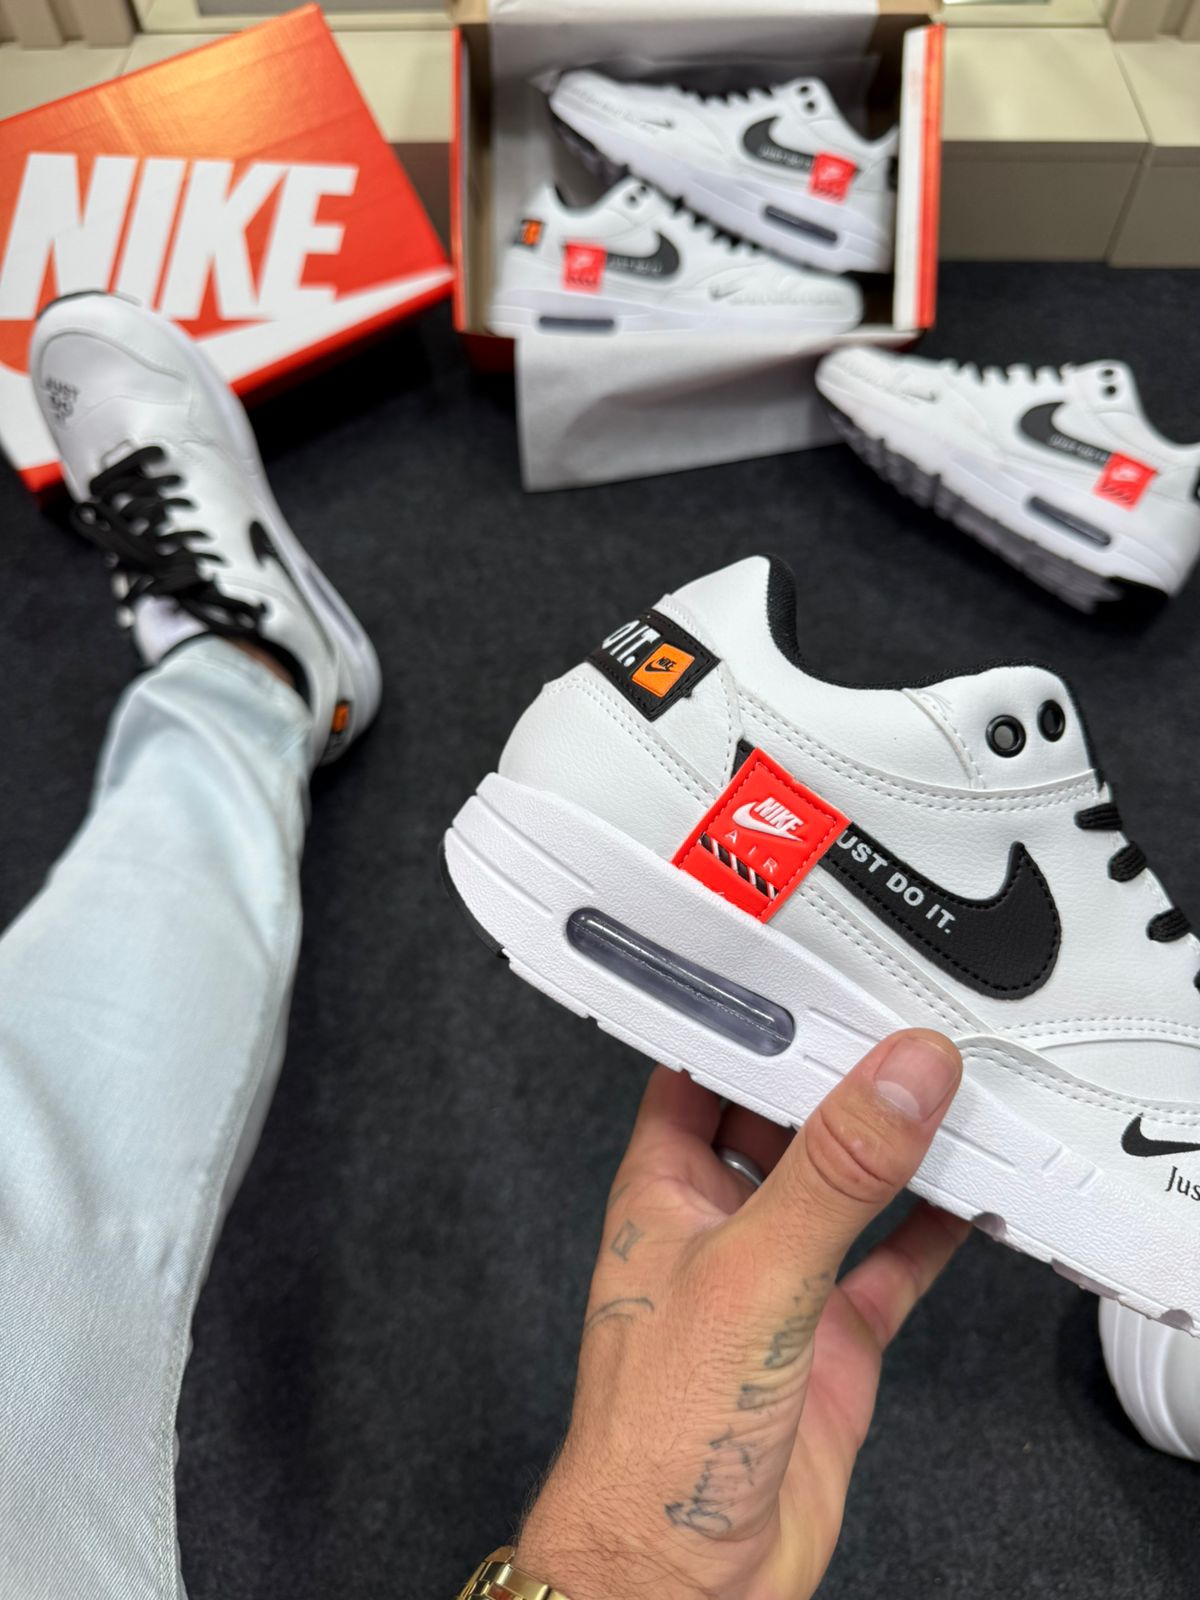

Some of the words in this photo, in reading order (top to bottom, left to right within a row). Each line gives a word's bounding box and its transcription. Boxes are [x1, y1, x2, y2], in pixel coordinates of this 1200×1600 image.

[0, 153, 359, 321] NIKE
[753, 797, 804, 831] NIKE
[725, 829, 778, 874] AIR
[836, 830, 888, 873] UST
[886, 872, 924, 906] DO
[926, 904, 956, 933] IT.
[1165, 1165, 1200, 1201] Jus
